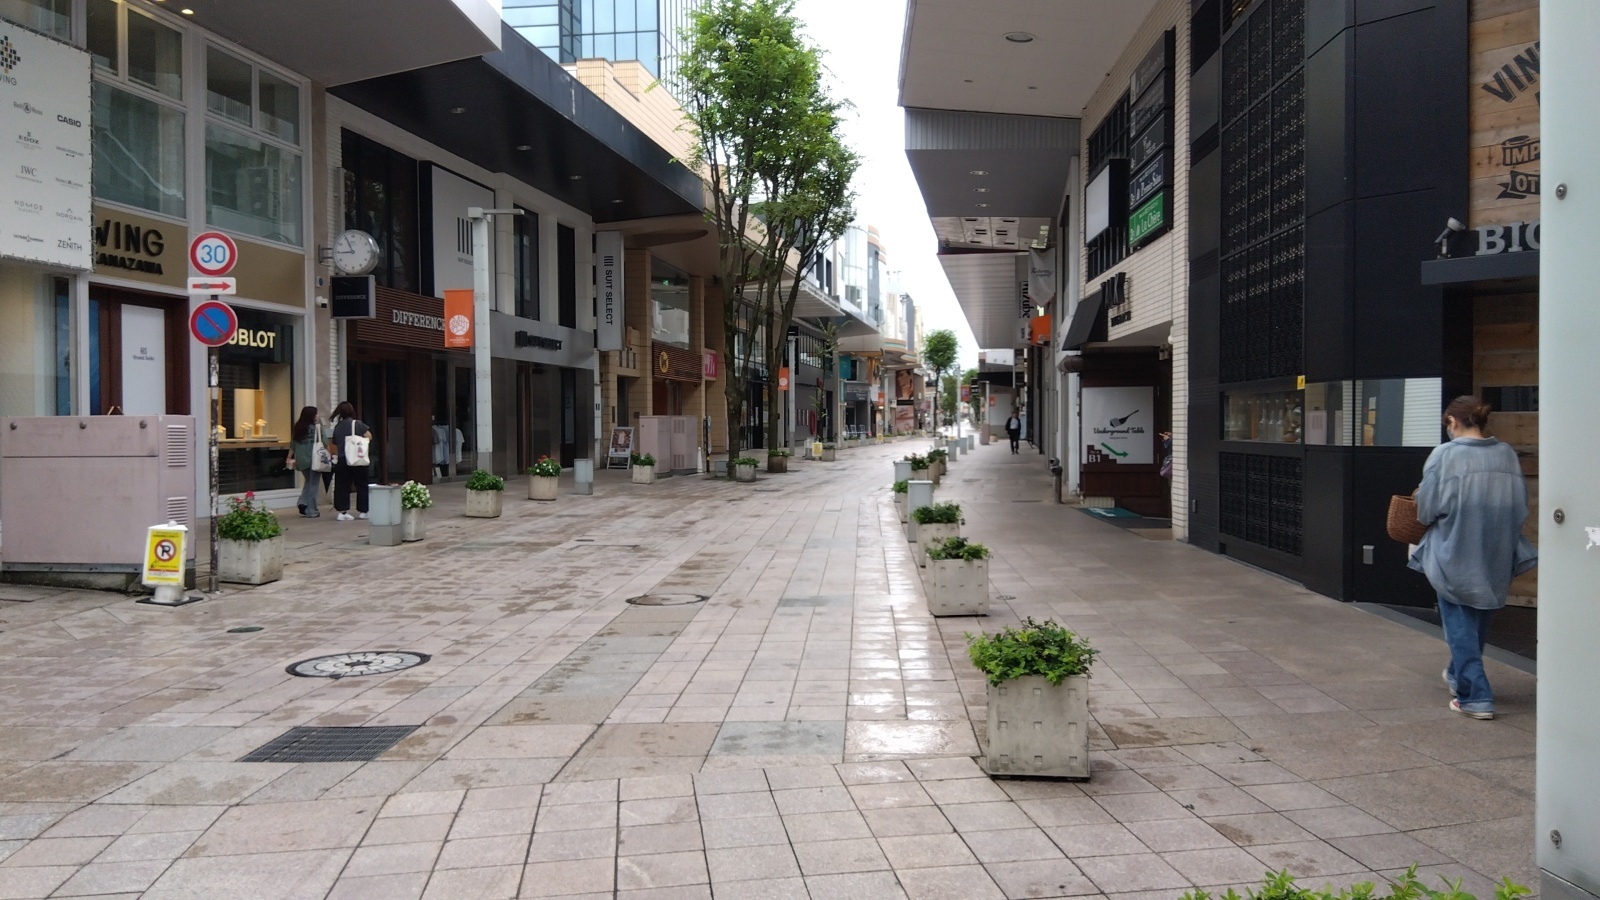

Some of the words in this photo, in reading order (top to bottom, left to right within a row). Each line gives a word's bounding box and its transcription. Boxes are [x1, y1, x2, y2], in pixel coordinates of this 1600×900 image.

[57, 114, 81, 128] CASIO
[19, 134, 40, 145] EDOX
[21, 165, 37, 177] IWC
[14, 200, 42, 211] NOMOS
[57, 239, 82, 251] ZENITH
[201, 244, 226, 264] 30
[1093, 427, 1130, 436] Underground
[1088, 454, 1101, 463] B1
